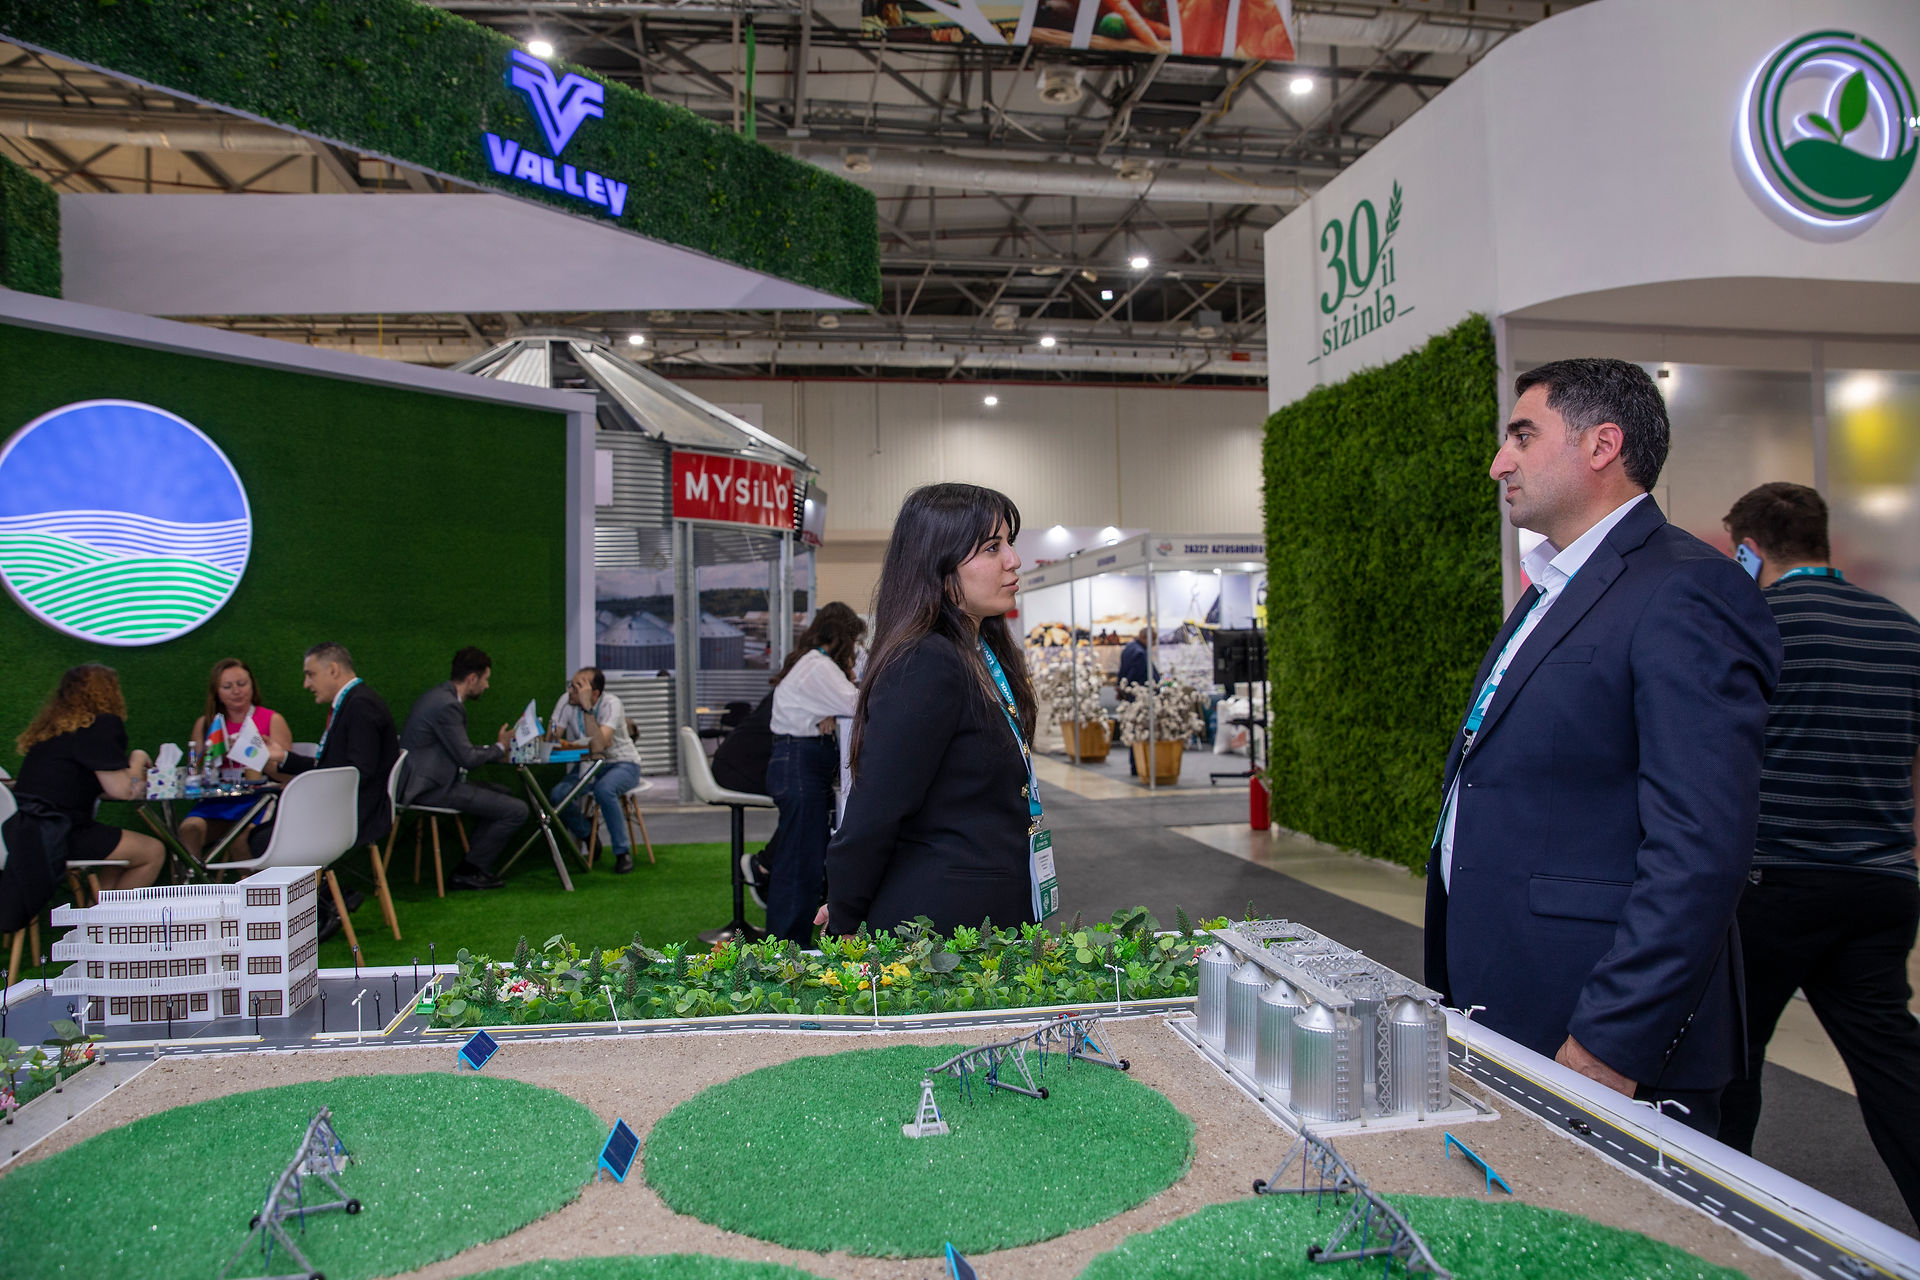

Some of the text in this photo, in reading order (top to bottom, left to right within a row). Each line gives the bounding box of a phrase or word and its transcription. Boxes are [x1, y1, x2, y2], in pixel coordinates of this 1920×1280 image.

[485, 132, 628, 216] VALLEY
[1320, 199, 1396, 315] 30 il
[1322, 288, 1396, 357] sizinlə
